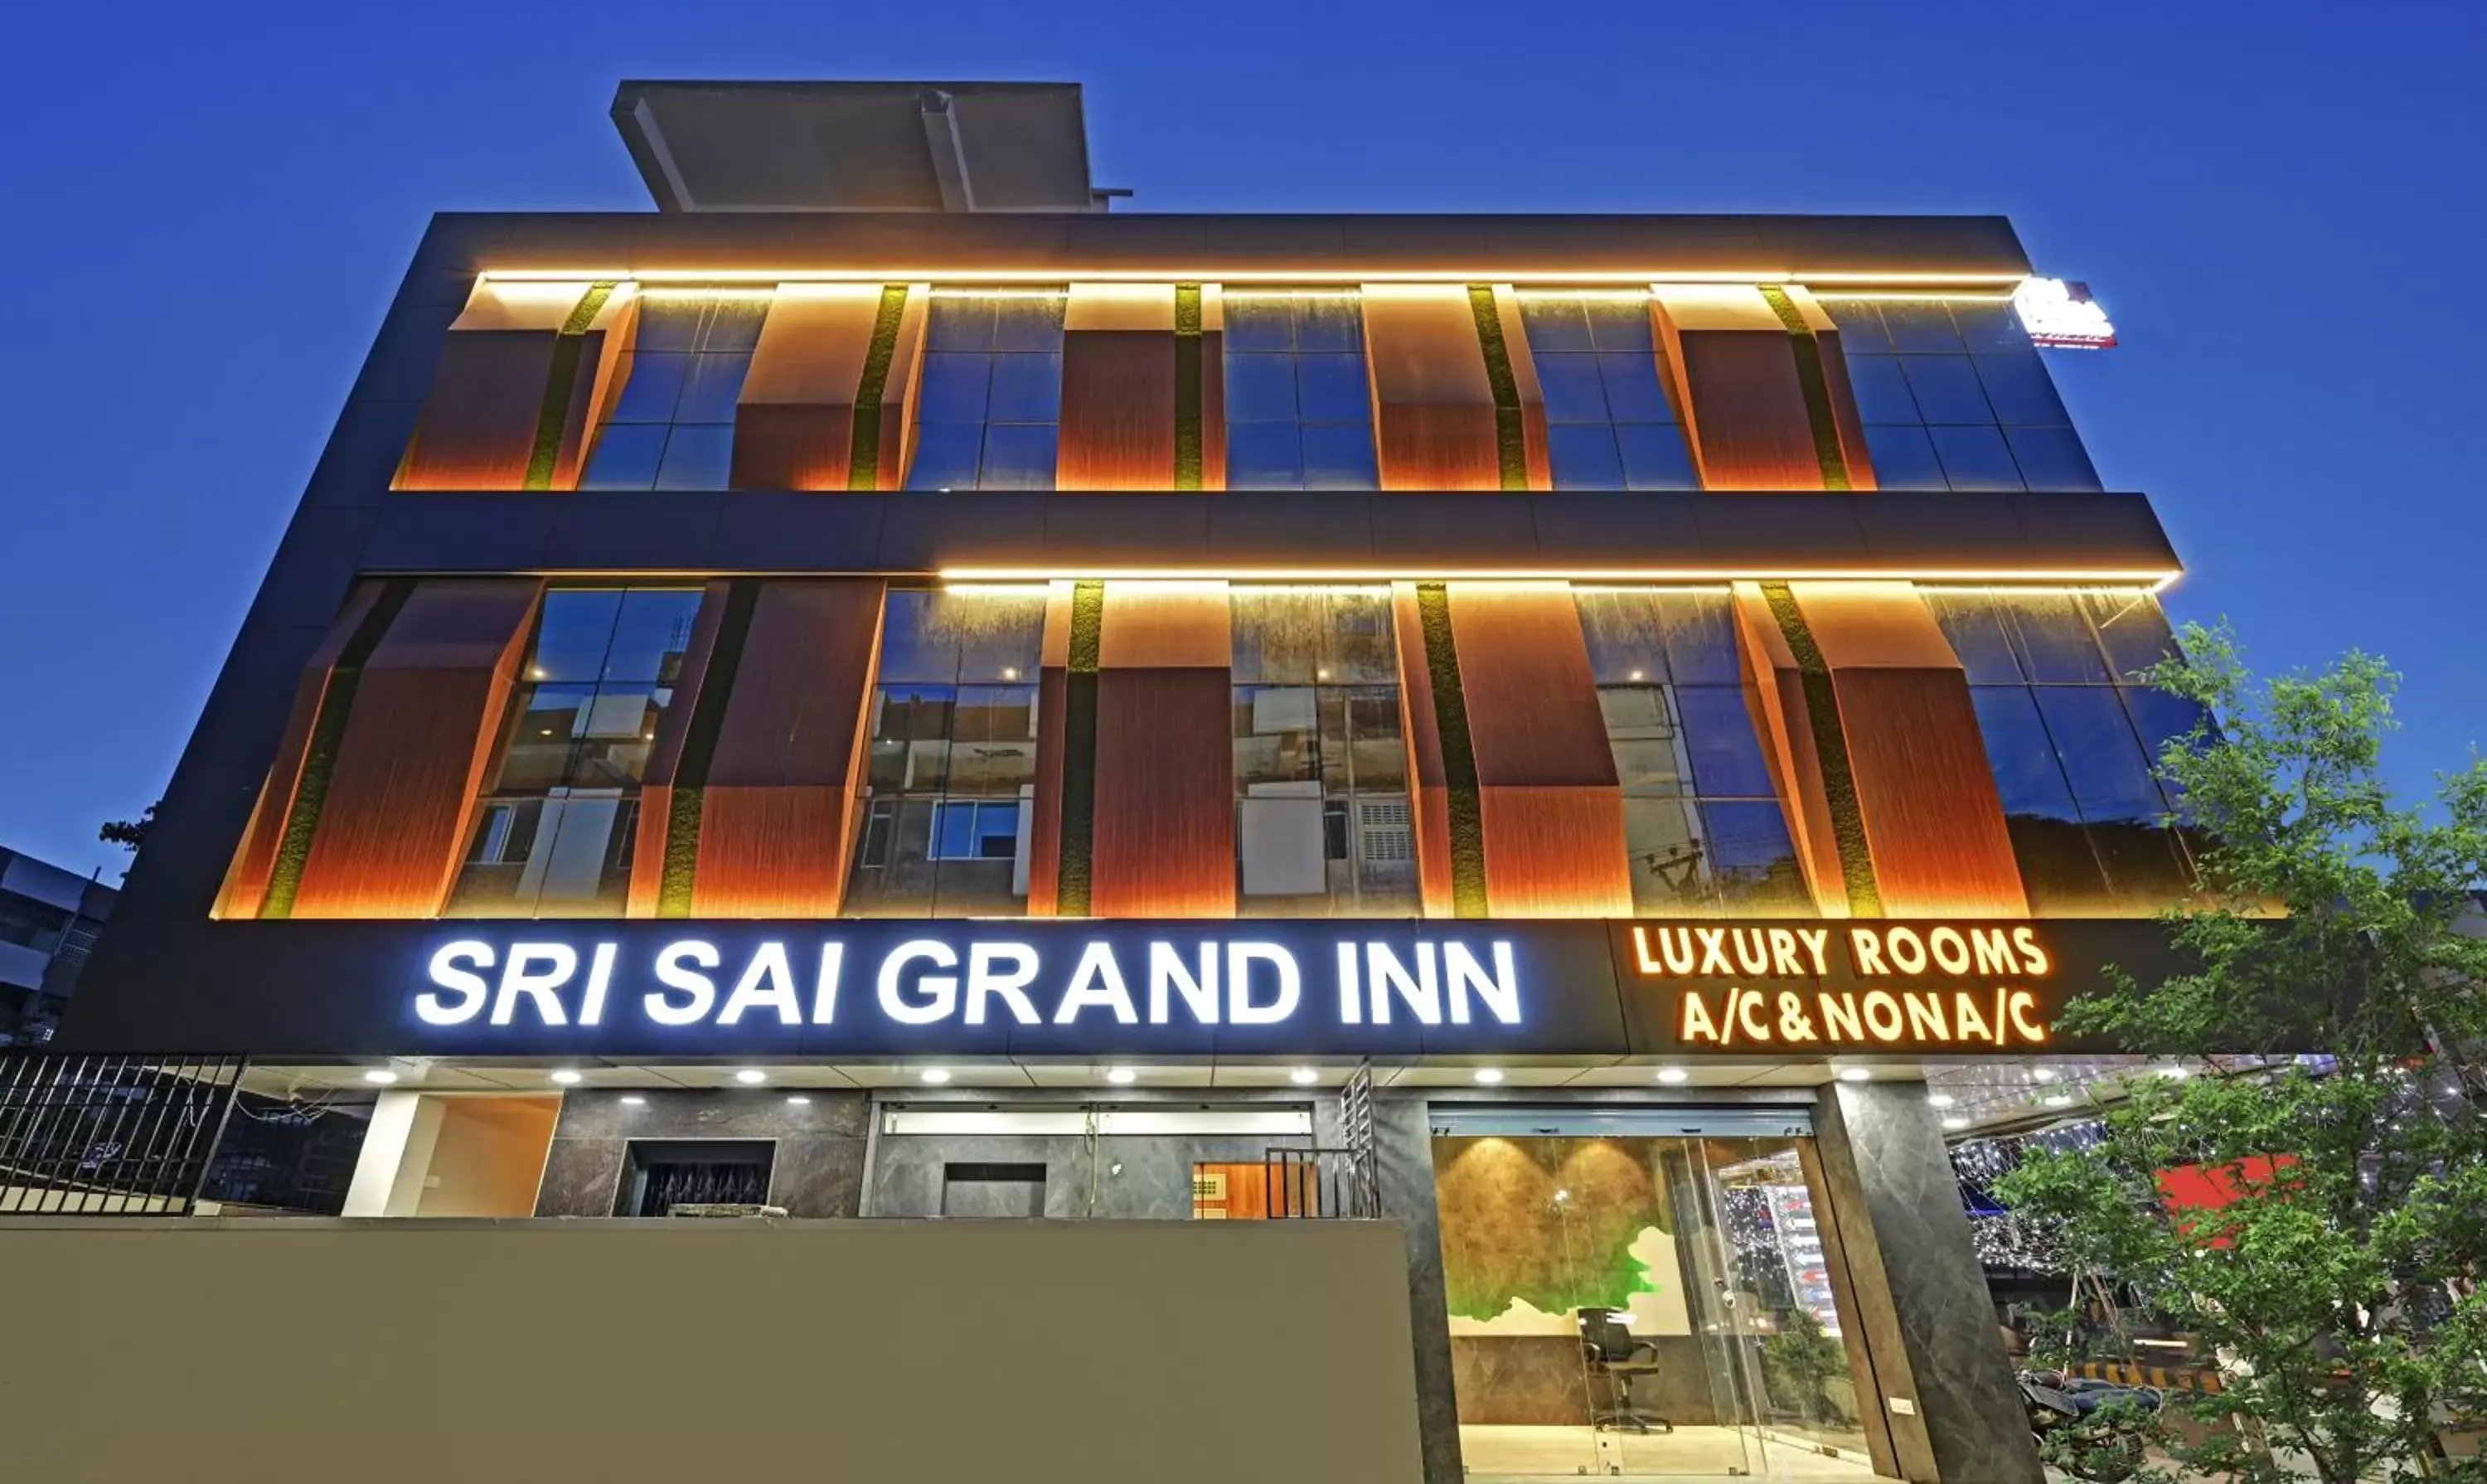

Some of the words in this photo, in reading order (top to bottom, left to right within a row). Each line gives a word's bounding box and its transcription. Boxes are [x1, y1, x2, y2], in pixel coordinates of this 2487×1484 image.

[415, 940, 617, 1025] SRI
[644, 940, 844, 1025] SAI
[877, 940, 1302, 1025] GRAND
[1337, 941, 1522, 1025] INN
[1632, 927, 1828, 975] LUXURY
[1851, 926, 2048, 975] ROOMS
